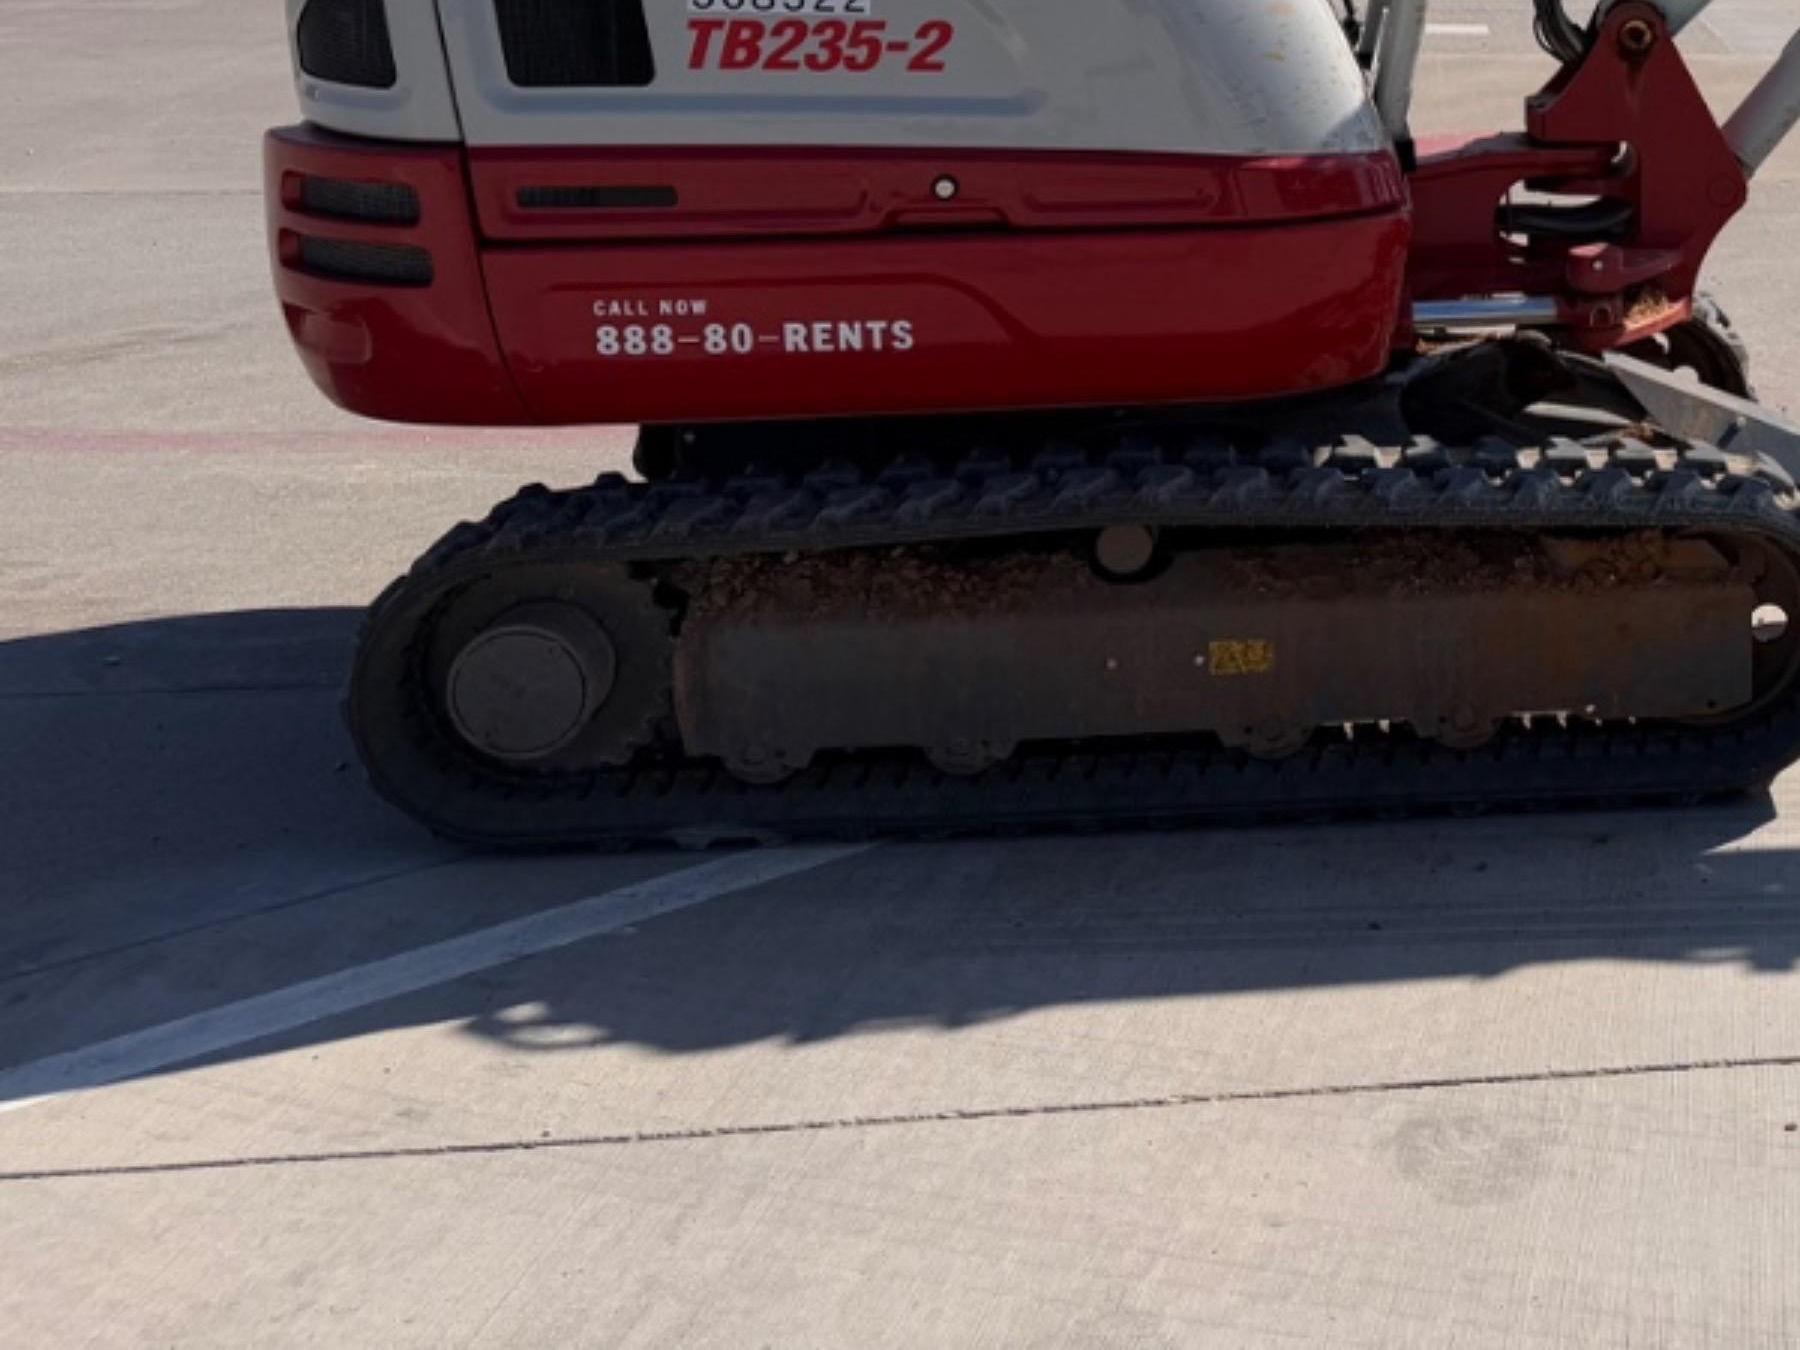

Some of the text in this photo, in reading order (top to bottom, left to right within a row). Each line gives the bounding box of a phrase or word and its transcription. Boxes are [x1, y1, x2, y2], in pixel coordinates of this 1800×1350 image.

[686, 18, 954, 72] TB235-2
[593, 299, 707, 317] CALL NOW
[596, 321, 914, 355] 888-80-RENTS
